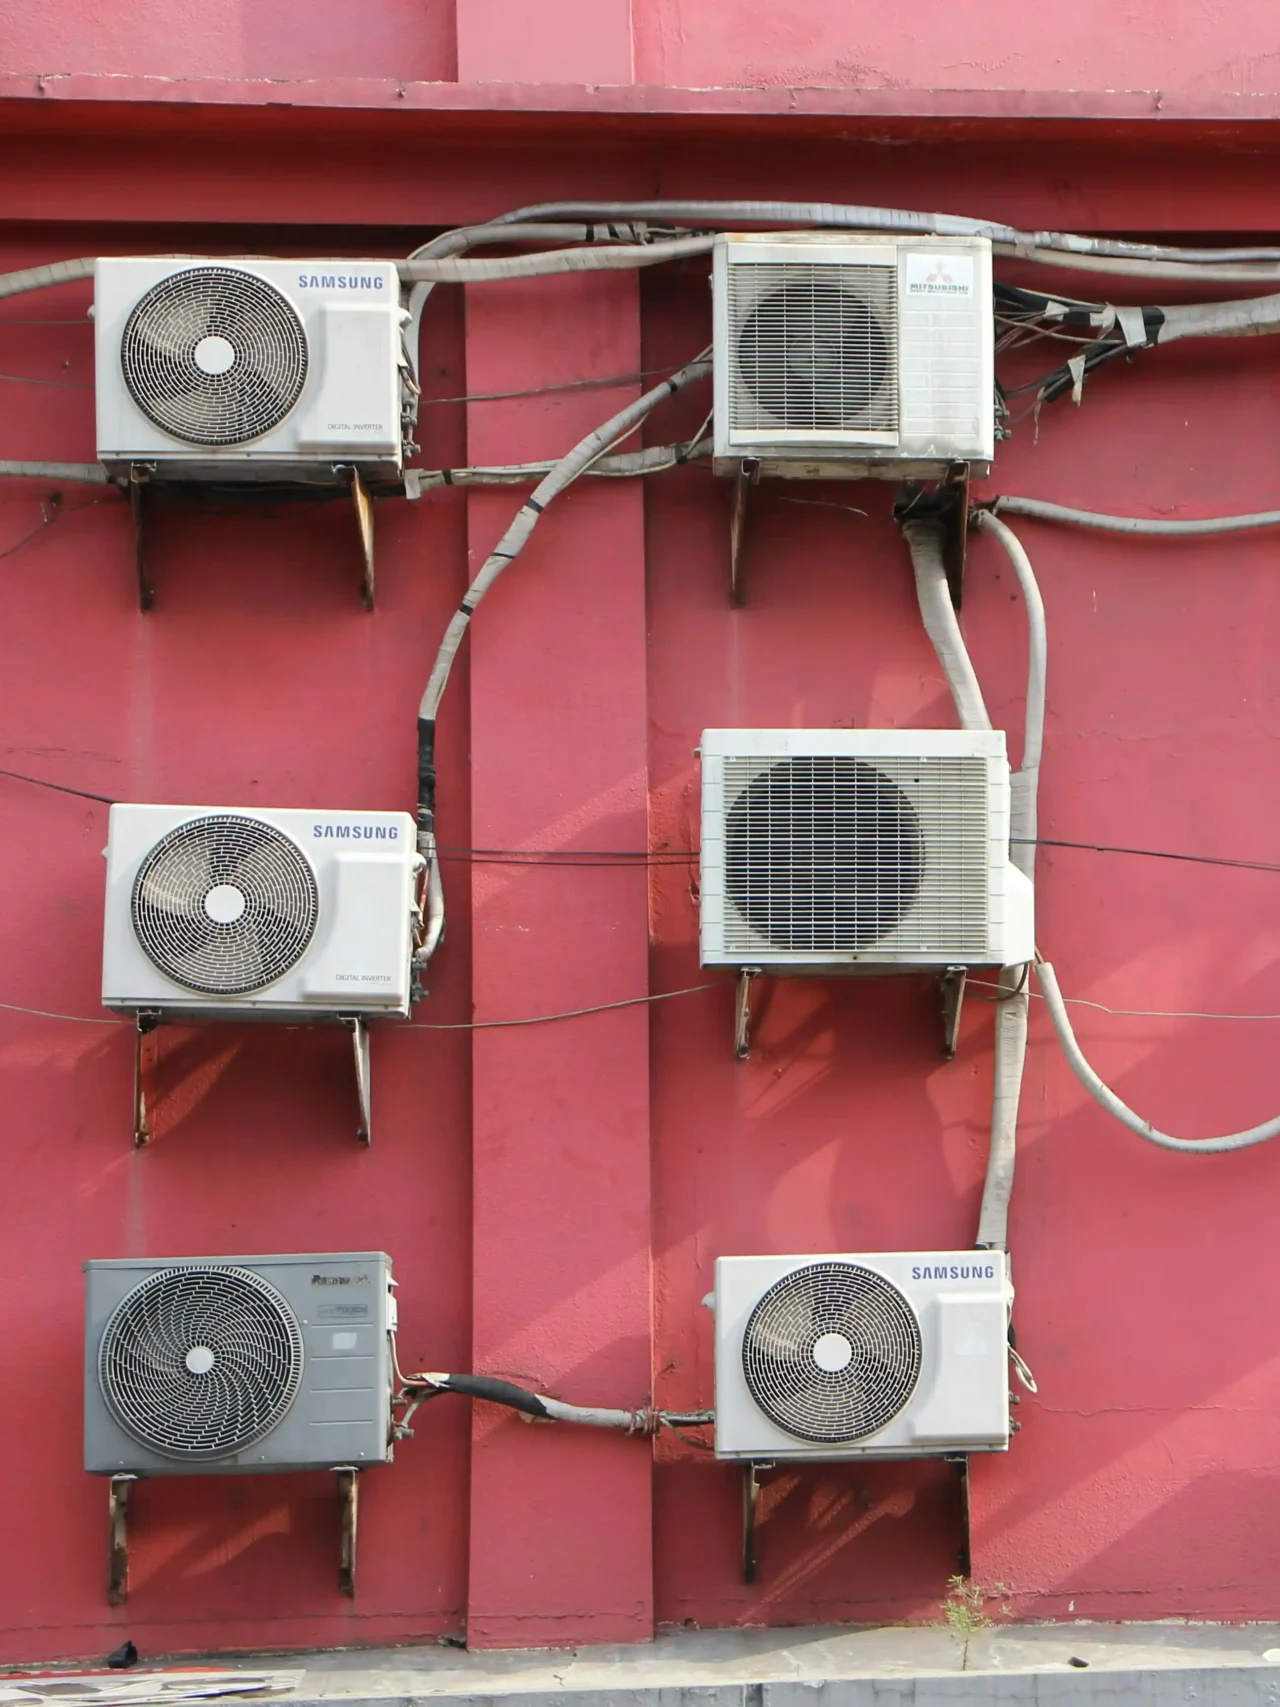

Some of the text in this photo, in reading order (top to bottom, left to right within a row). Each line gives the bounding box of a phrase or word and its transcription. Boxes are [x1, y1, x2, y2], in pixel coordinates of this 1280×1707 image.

[298, 275, 383, 289] SAMSUNG
[910, 283, 969, 291] MITSUBISHI
[313, 825, 398, 840] SAMSUNG
[912, 1266, 994, 1279] SAMSUNG
